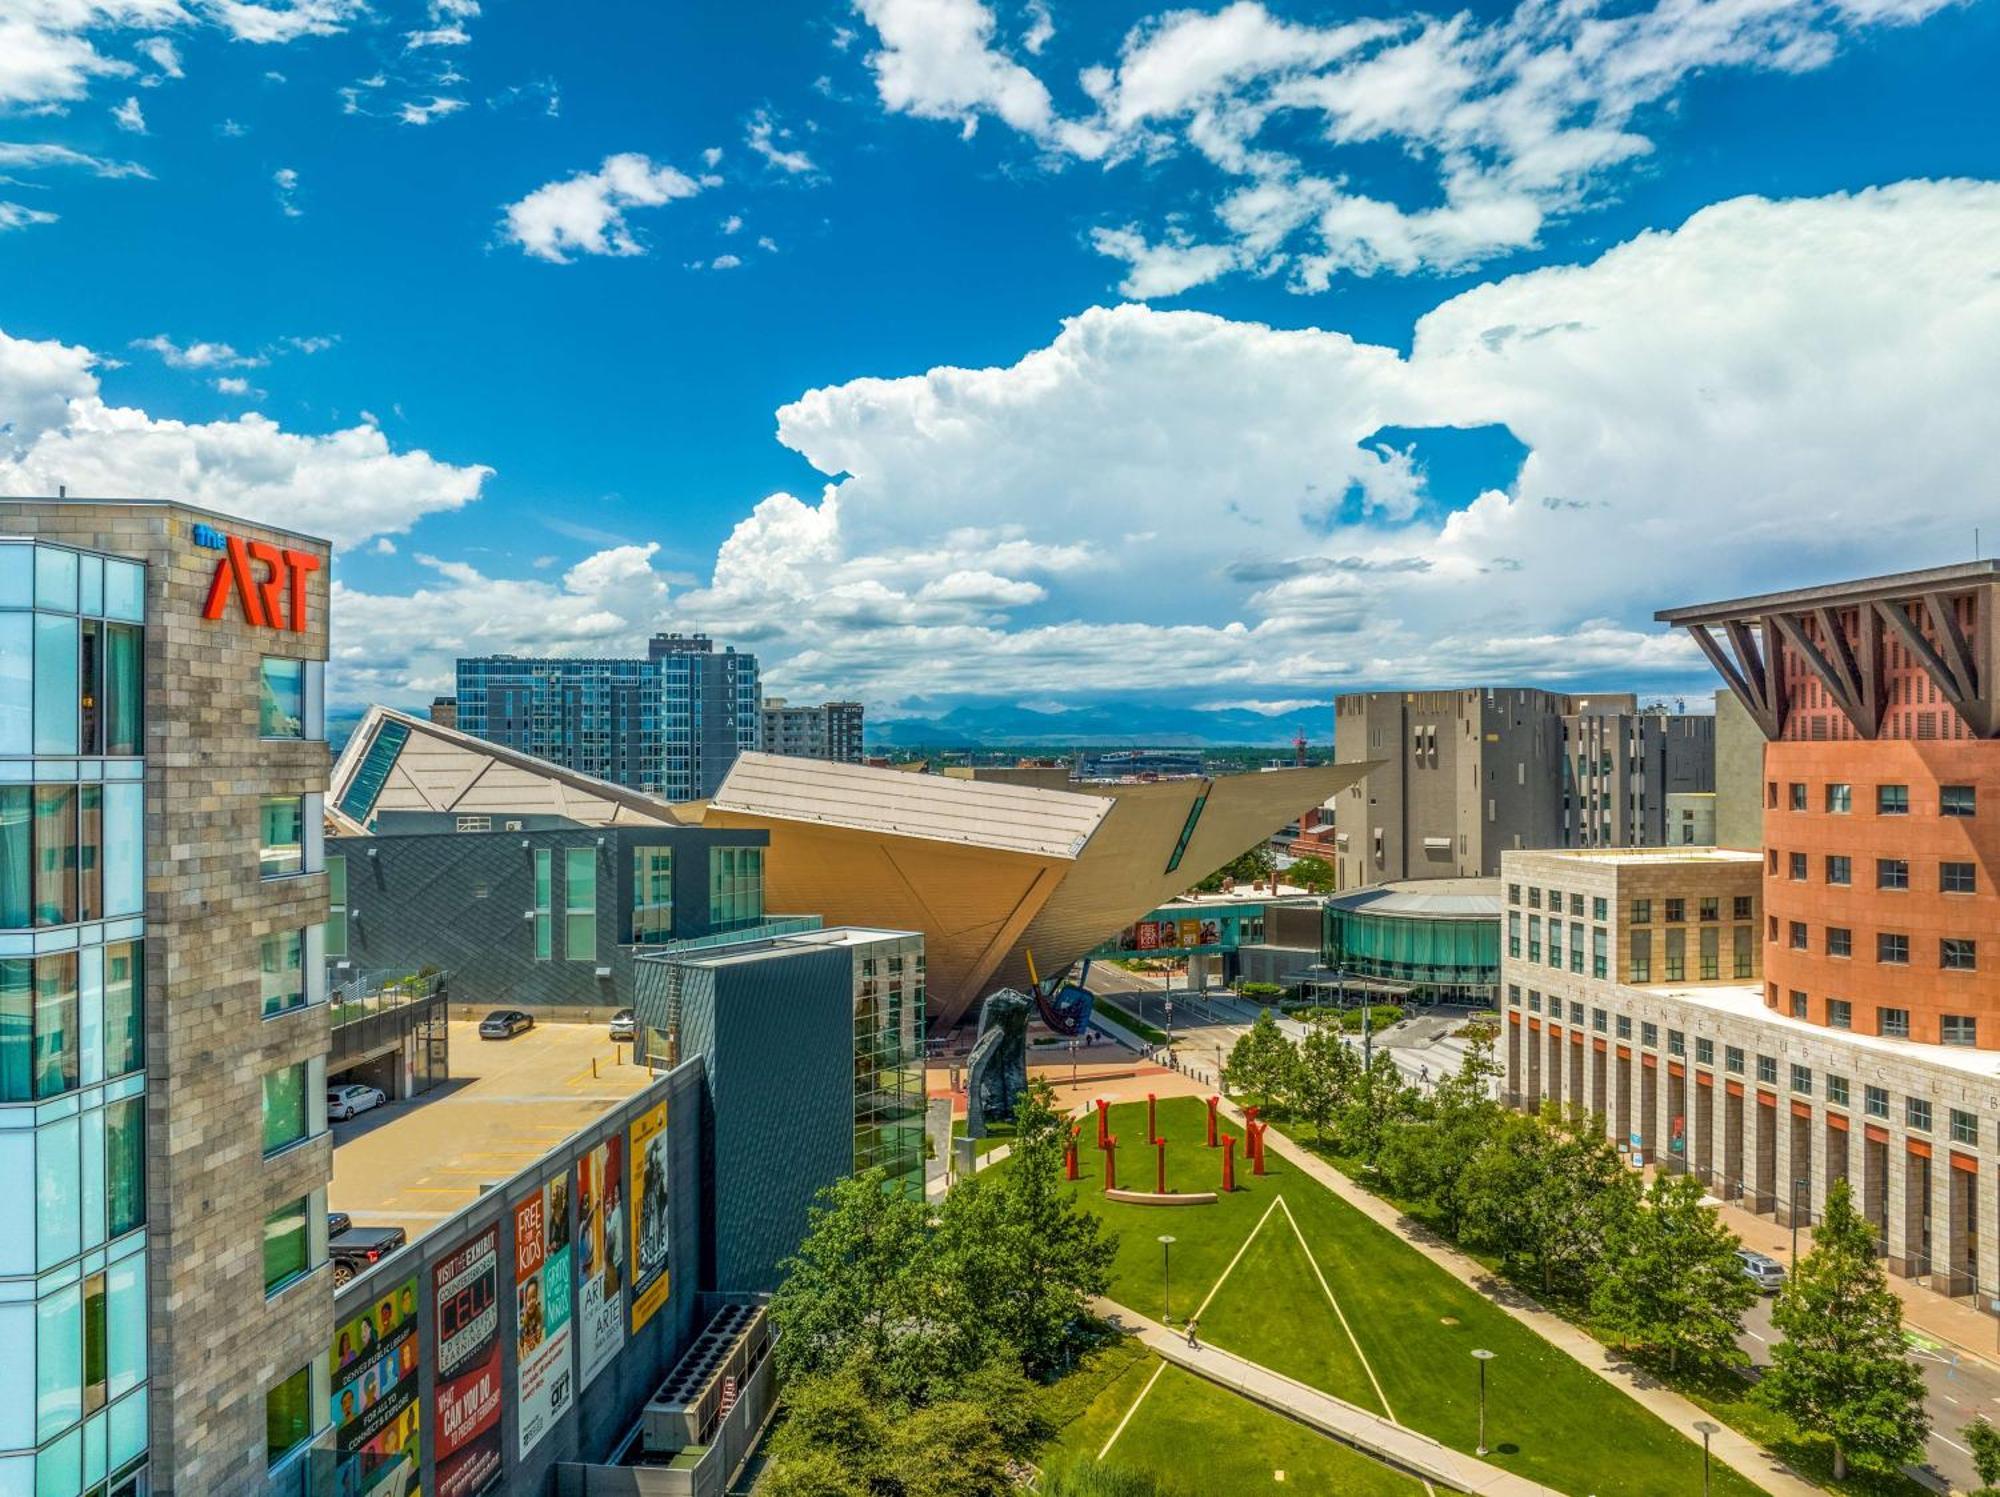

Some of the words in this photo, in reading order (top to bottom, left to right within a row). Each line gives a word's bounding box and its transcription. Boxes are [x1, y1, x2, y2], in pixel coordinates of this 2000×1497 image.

[203, 534, 320, 633] ART
[727, 660, 735, 728] EVIVA
[1626, 1000, 1722, 1035] DENVER
[1756, 1034, 1888, 1079] PUBLIC
[518, 1199, 542, 1243] FREE
[437, 1259, 456, 1286] VISIT
[466, 1231, 496, 1265] EXHIBIT
[519, 1230, 541, 1273] KIDS
[442, 1278, 494, 1341] CELL
[585, 1274, 604, 1312] ART
[444, 1398, 462, 1437] CAN
[463, 1383, 478, 1420] YOU
[551, 1369, 570, 1408] art
